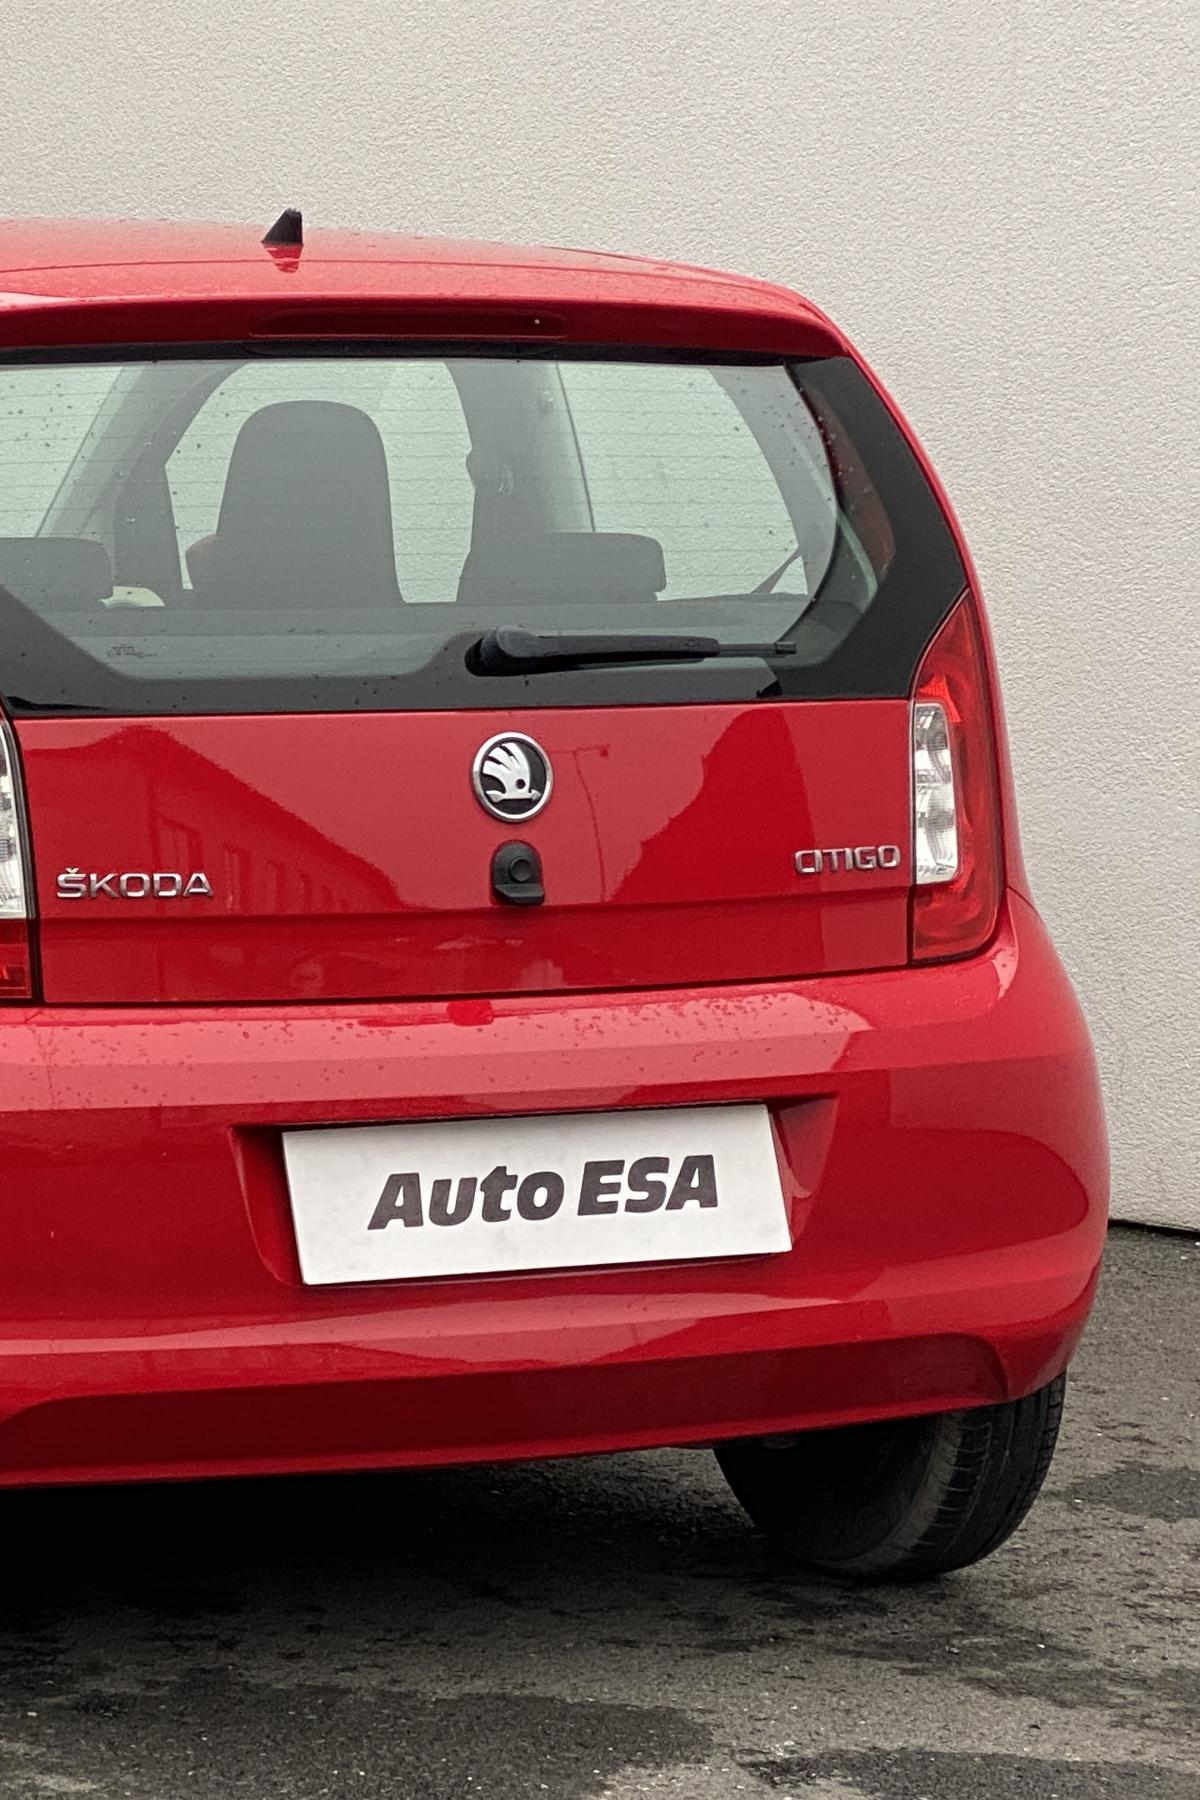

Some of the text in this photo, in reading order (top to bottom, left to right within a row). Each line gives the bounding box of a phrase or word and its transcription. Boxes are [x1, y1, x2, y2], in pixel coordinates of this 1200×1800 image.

[795, 845, 901, 874] CITIGO
[56, 867, 213, 899] ŠKODA
[367, 1154, 718, 1230] Auto ESA
